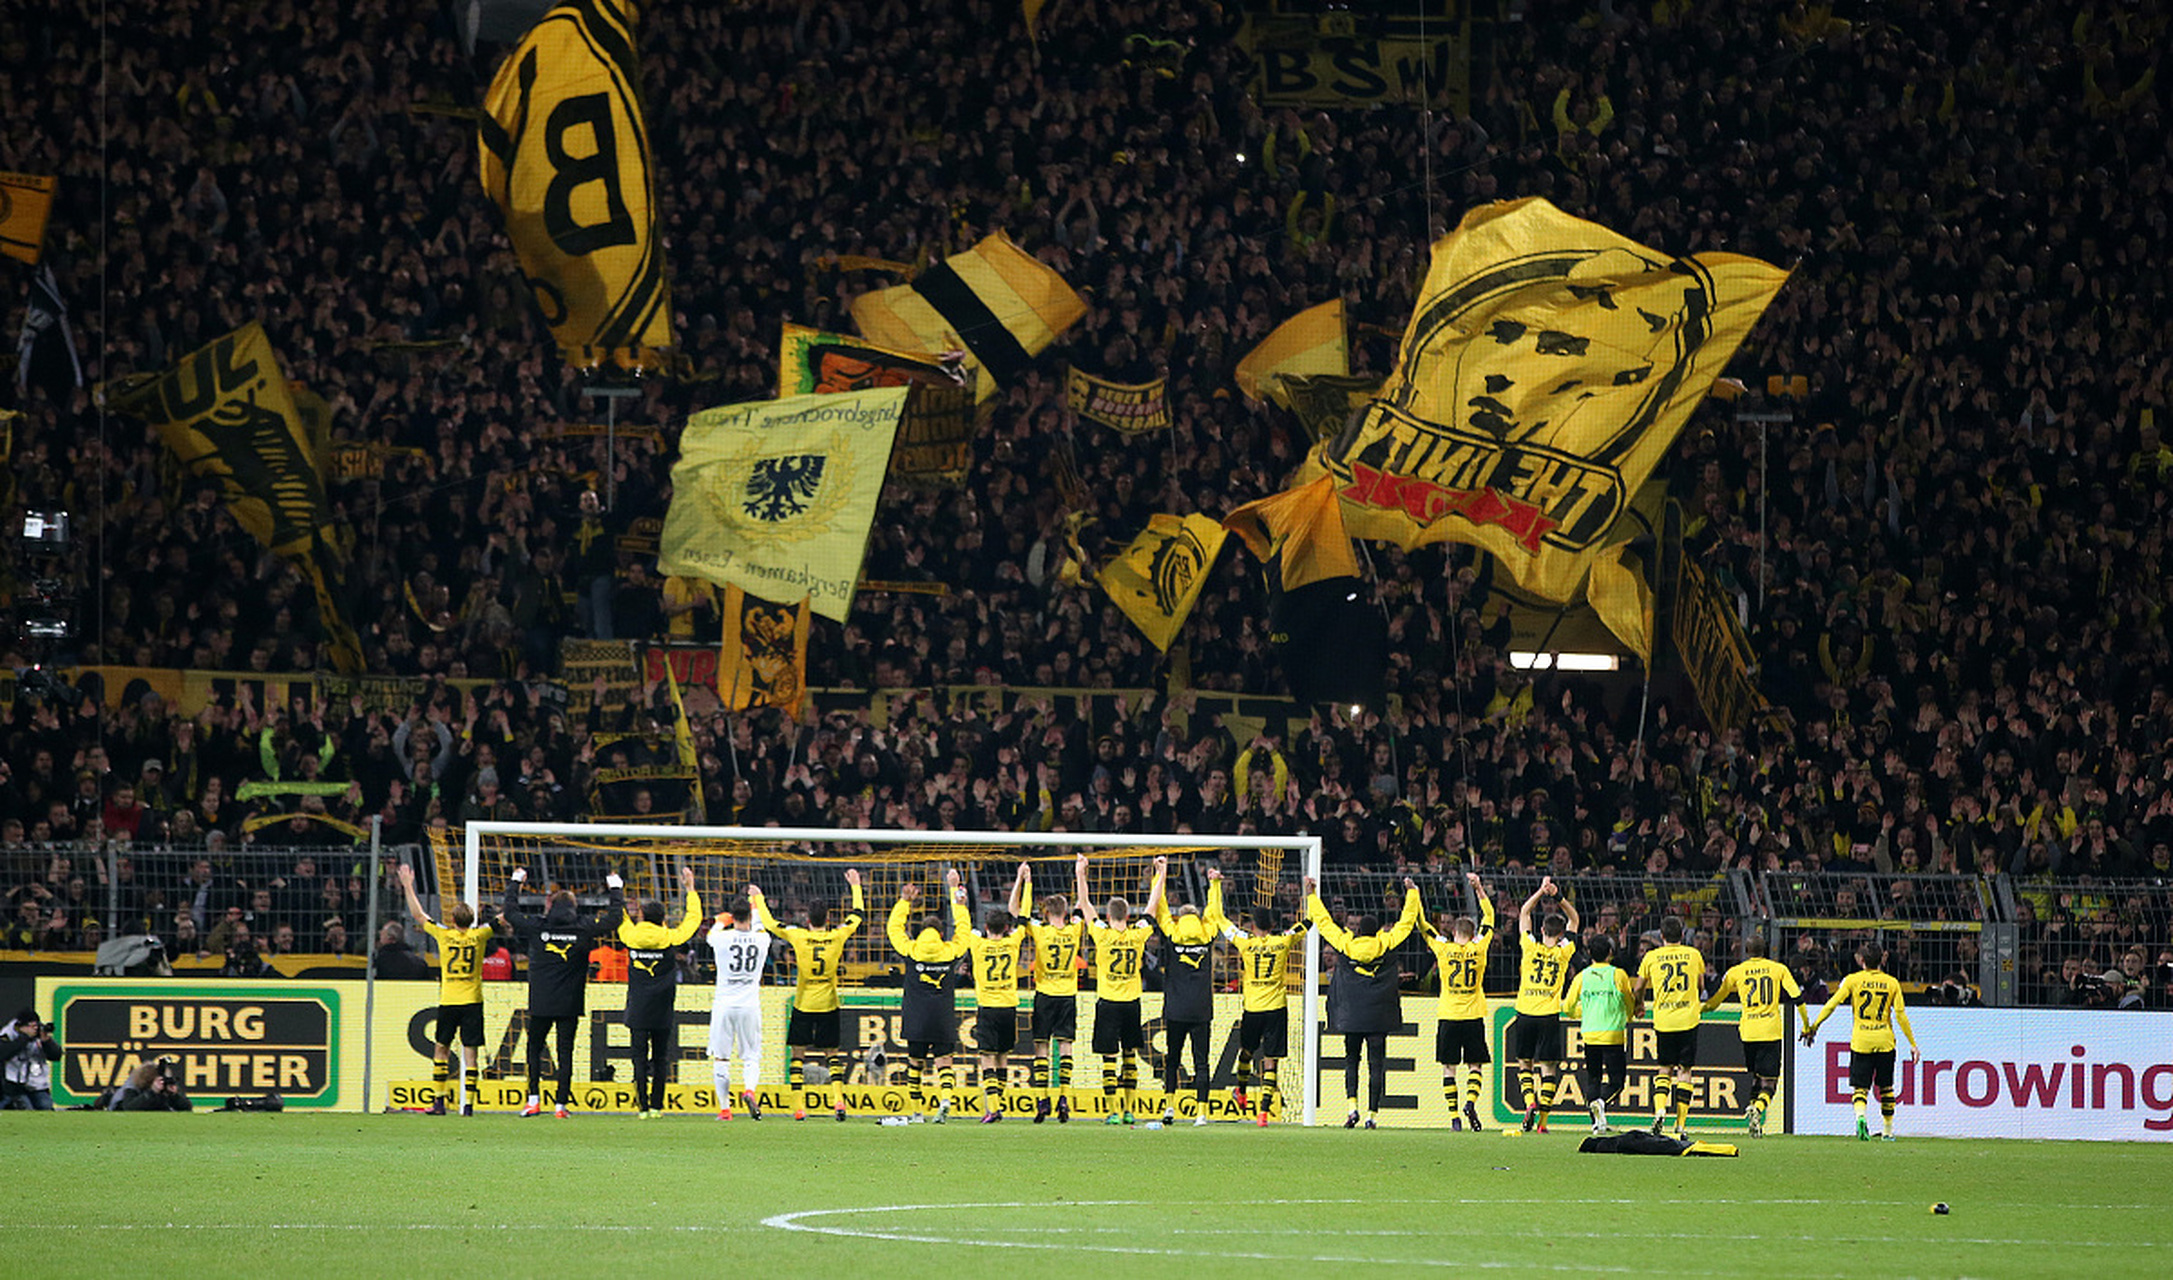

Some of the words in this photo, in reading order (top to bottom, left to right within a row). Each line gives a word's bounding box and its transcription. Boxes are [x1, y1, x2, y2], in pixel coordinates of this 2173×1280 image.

[447, 945, 475, 974] 29
[729, 944, 758, 972] 38
[811, 946, 825, 976] 5
[984, 953, 1011, 981] 22
[1046, 944, 1075, 971] 37
[1109, 948, 1137, 974] 28
[1254, 953, 1276, 979] 17
[1448, 959, 1477, 987] 26
[1530, 958, 1559, 987] 33
[1660, 961, 1688, 993] 25
[1744, 976, 1773, 1007] 20
[1859, 990, 1888, 1020] 27
[129, 1005, 266, 1039] BURG
[393, 1087, 489, 1105] SIGNL
[498, 1089, 578, 1108] IDNA
